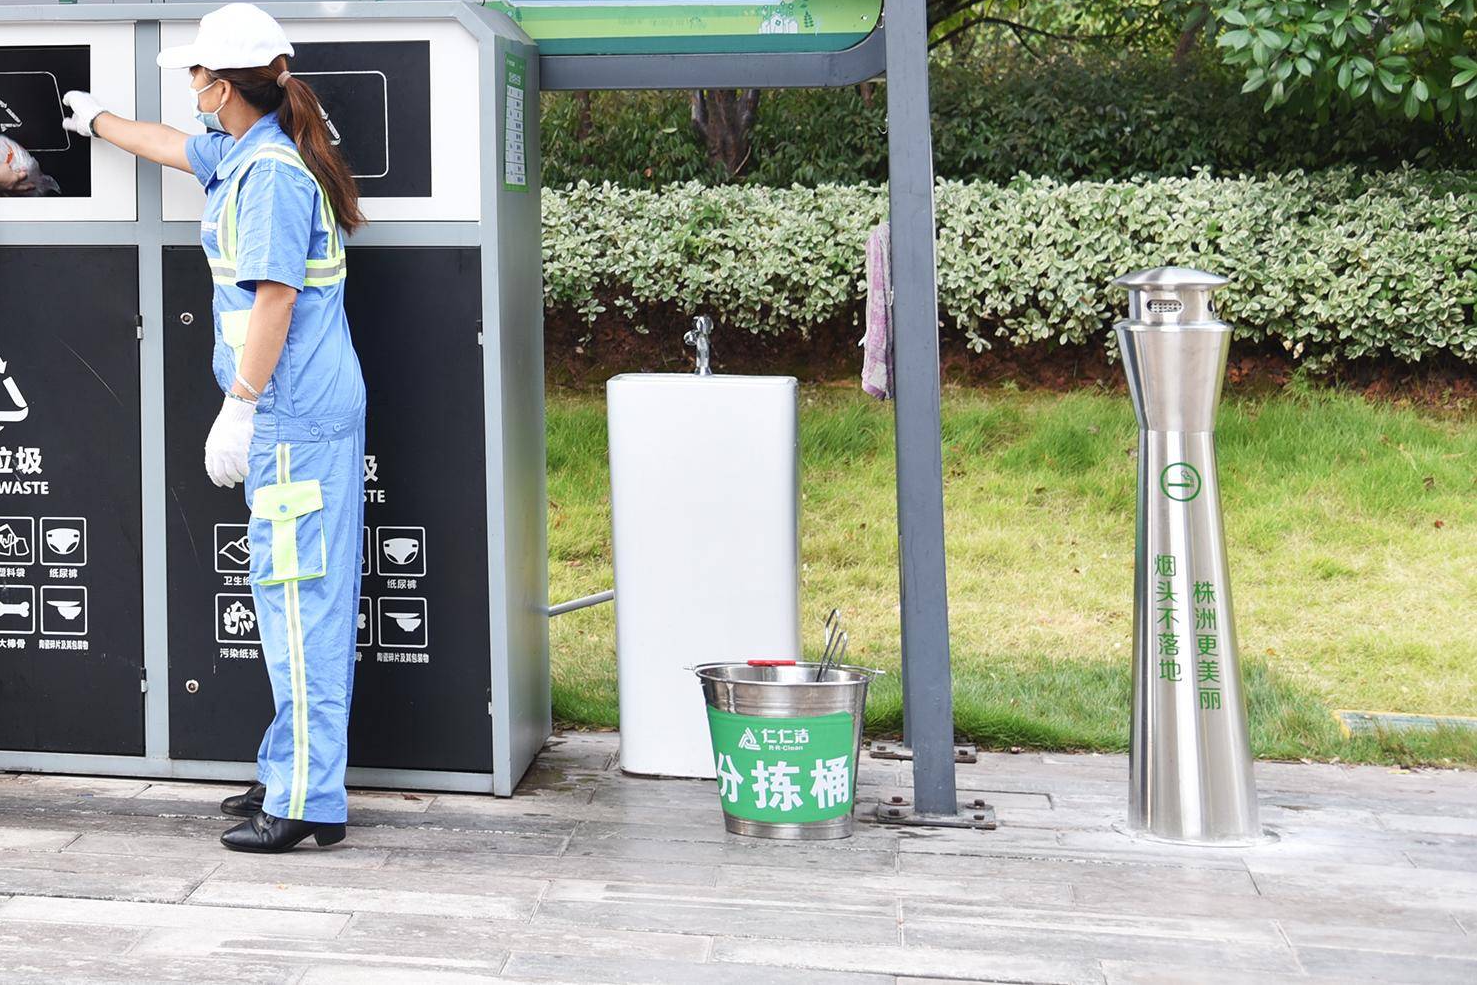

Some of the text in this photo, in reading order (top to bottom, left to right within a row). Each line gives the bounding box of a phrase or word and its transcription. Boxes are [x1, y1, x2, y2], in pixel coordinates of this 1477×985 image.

[49, 568, 78, 578] 纸尿裤
[387, 579, 417, 589] 纸尿裤
[1154, 554, 1183, 683] 烟头不落地
[219, 648, 259, 659] 污染纸张
[1192, 581, 1222, 711] 株洲更美丽
[761, 728, 809, 744] 仁仁洁
[717, 752, 849, 812] 分拣桶
